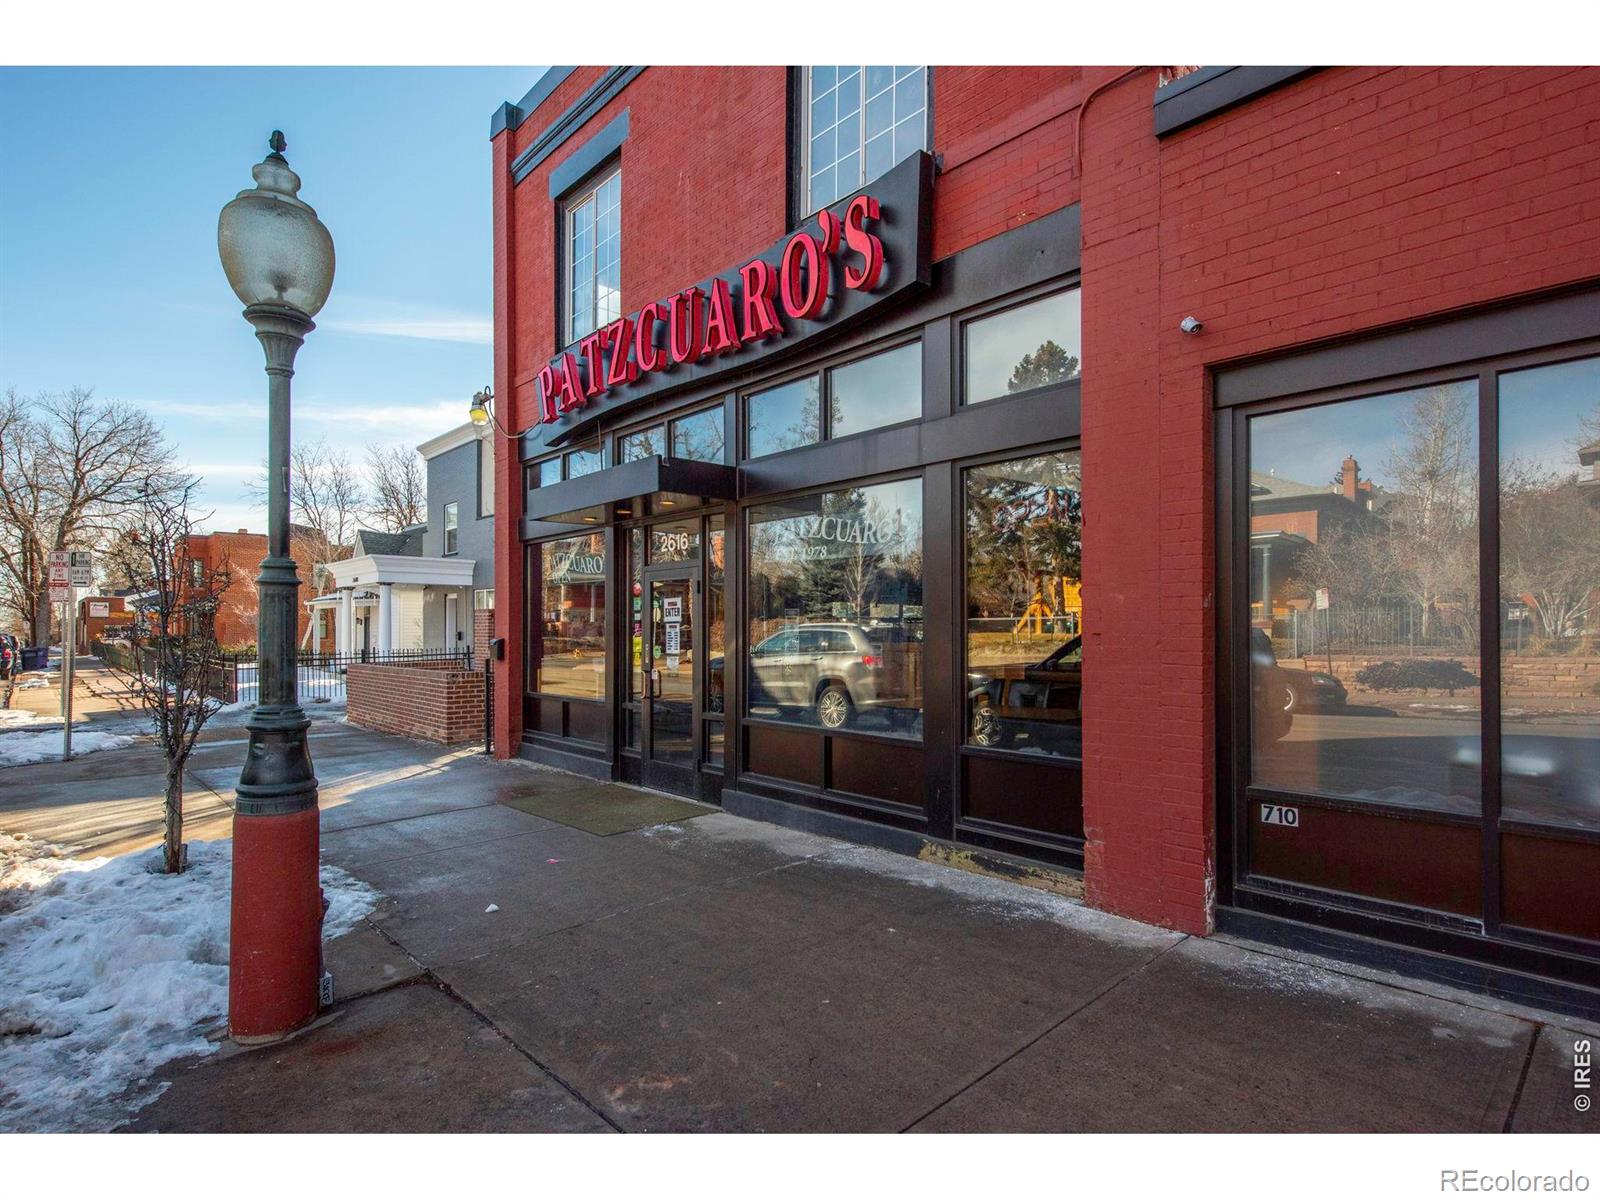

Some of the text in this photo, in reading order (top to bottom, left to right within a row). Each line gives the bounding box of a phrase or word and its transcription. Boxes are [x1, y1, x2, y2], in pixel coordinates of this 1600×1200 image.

[538, 195, 884, 424] PATZCUARO'S
[661, 533, 688, 552] 2616
[665, 607, 680, 617] ENTER
[1263, 805, 1297, 825] 710
